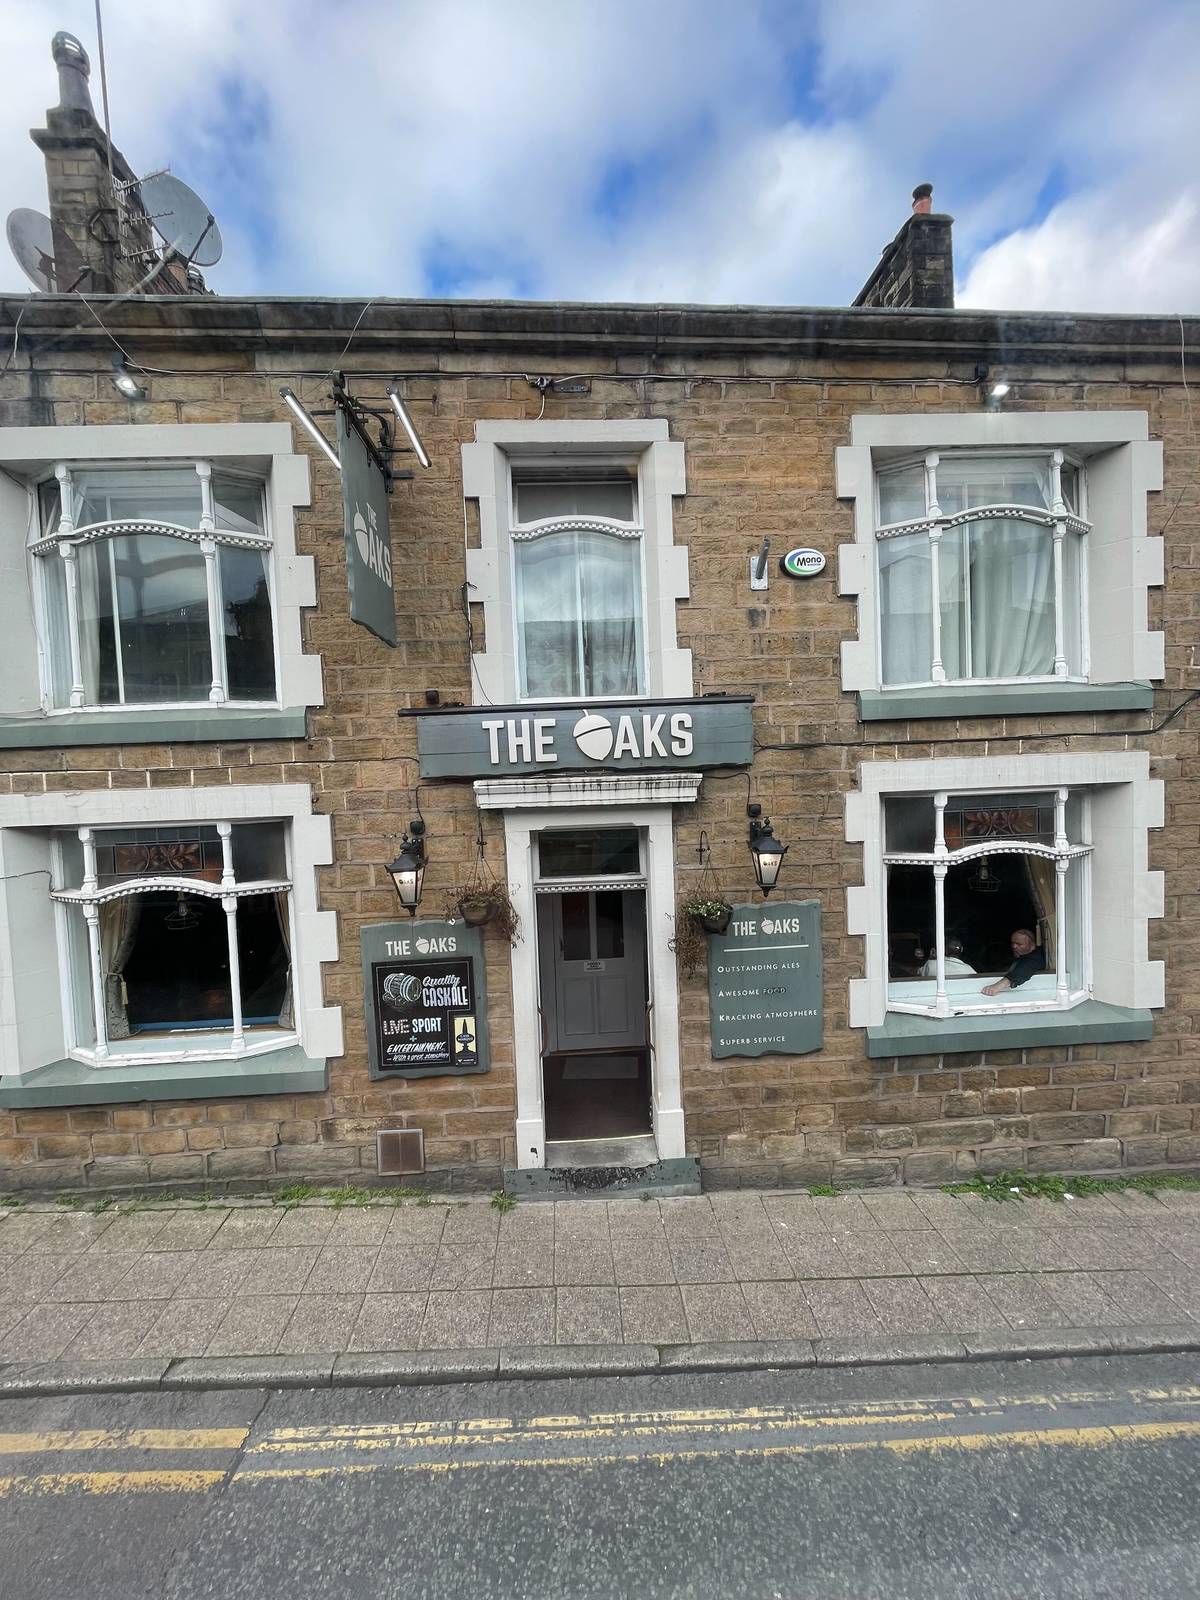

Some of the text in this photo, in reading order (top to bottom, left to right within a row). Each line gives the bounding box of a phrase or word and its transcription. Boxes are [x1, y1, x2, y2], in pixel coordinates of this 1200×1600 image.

[796, 556, 822, 567] Mono
[481, 718, 558, 764] THE
[732, 920, 757, 937] THE
[385, 940, 411, 956] THE
[717, 963, 778, 973] OUTSTANDING
[422, 974, 461, 988] Quality
[718, 989, 760, 997] AWESOME
[719, 1009, 817, 1022] KRACKING ATMOSPHERE
[412, 1017, 442, 1034] SPORT
[720, 1035, 786, 1046] SUPERB SERVICE
[386, 1041, 447, 1054] ENTERTAINMENT
